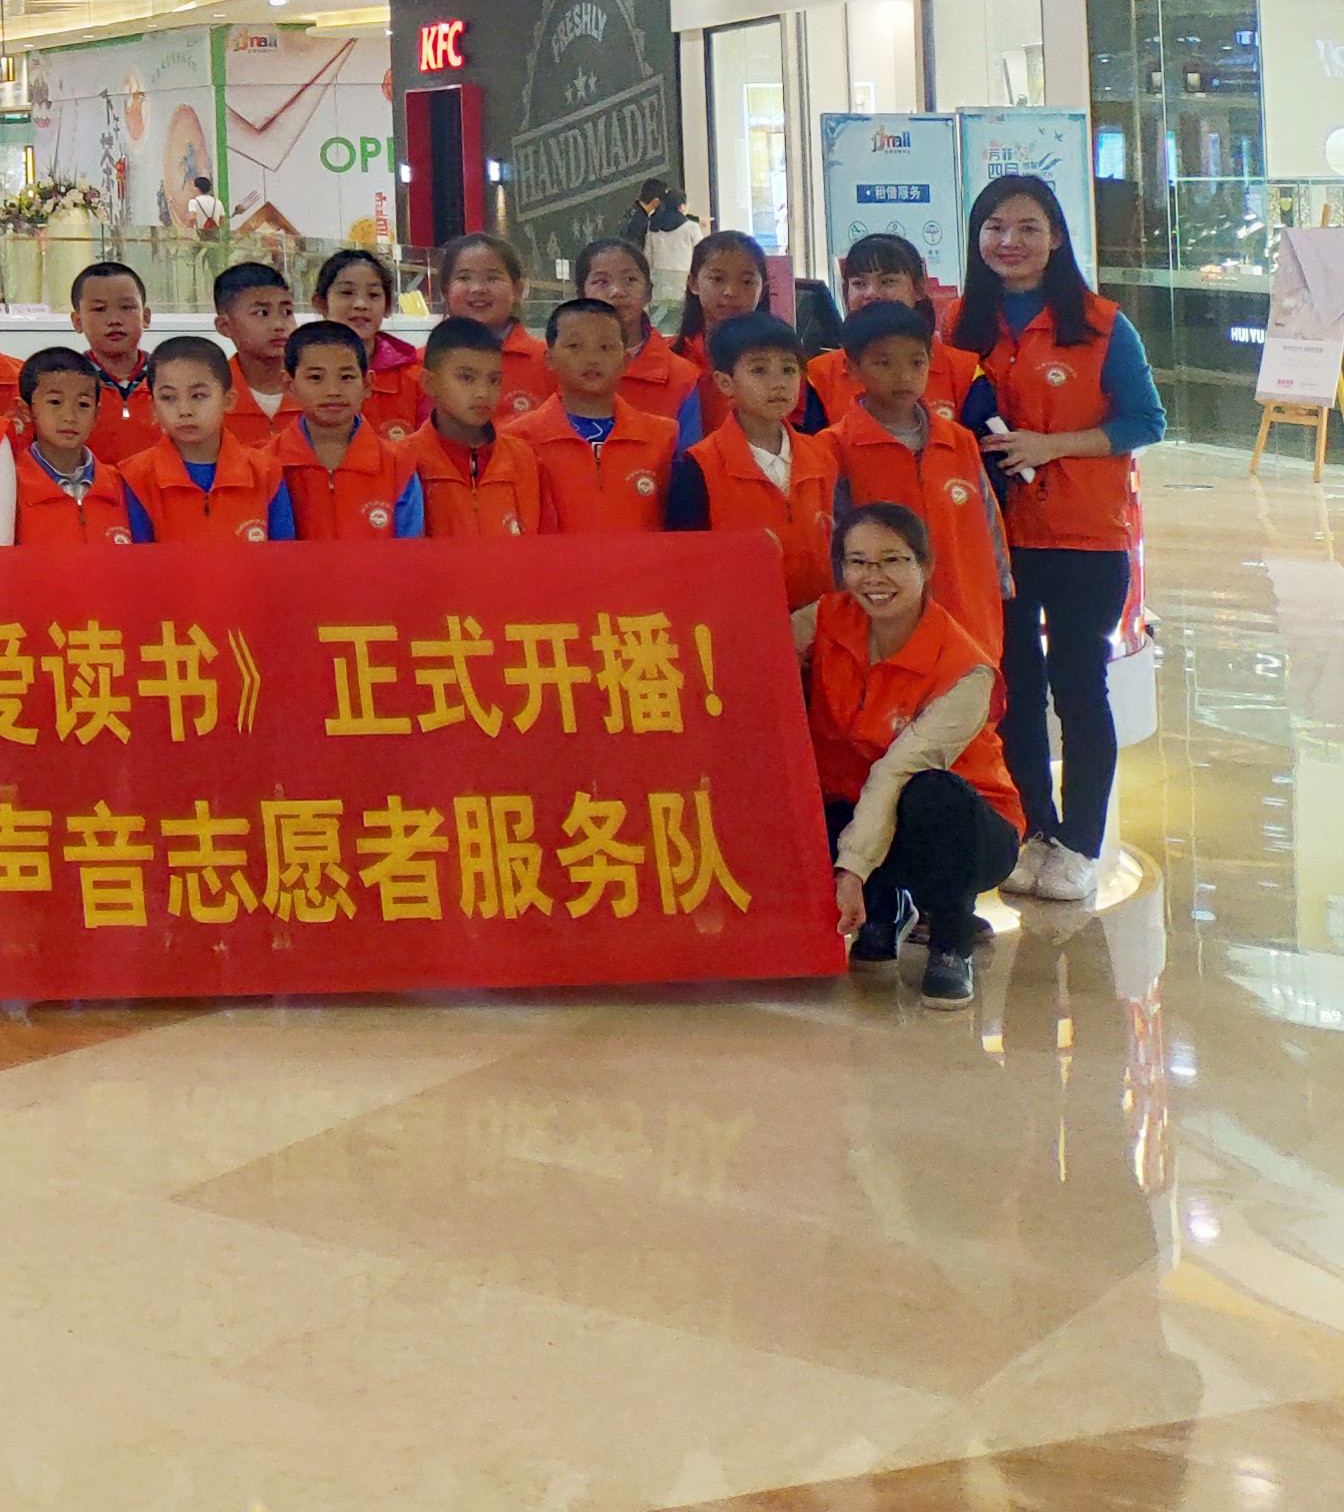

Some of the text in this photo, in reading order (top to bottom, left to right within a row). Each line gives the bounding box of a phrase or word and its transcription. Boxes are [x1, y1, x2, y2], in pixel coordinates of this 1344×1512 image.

[418, 19, 465, 73] KFC
[552, 0, 608, 64] FRESHLY
[514, 93, 664, 206] HANDMADE
